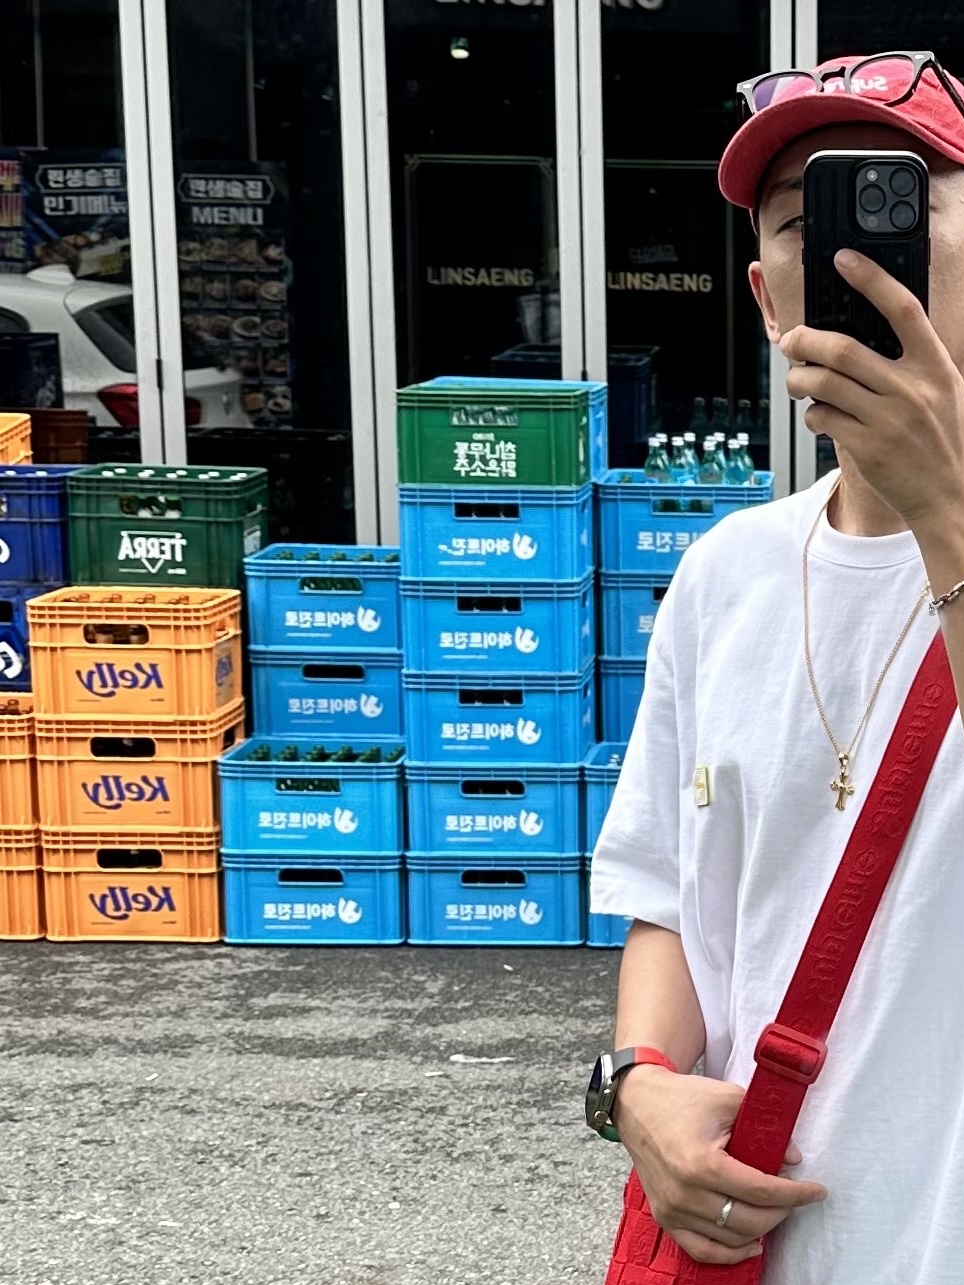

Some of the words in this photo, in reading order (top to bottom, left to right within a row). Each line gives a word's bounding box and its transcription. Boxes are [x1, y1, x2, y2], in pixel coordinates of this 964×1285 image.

[192, 206, 264, 226] MENU
[427, 266, 534, 287] LINSAENG
[607, 271, 712, 293] LINSAENG
